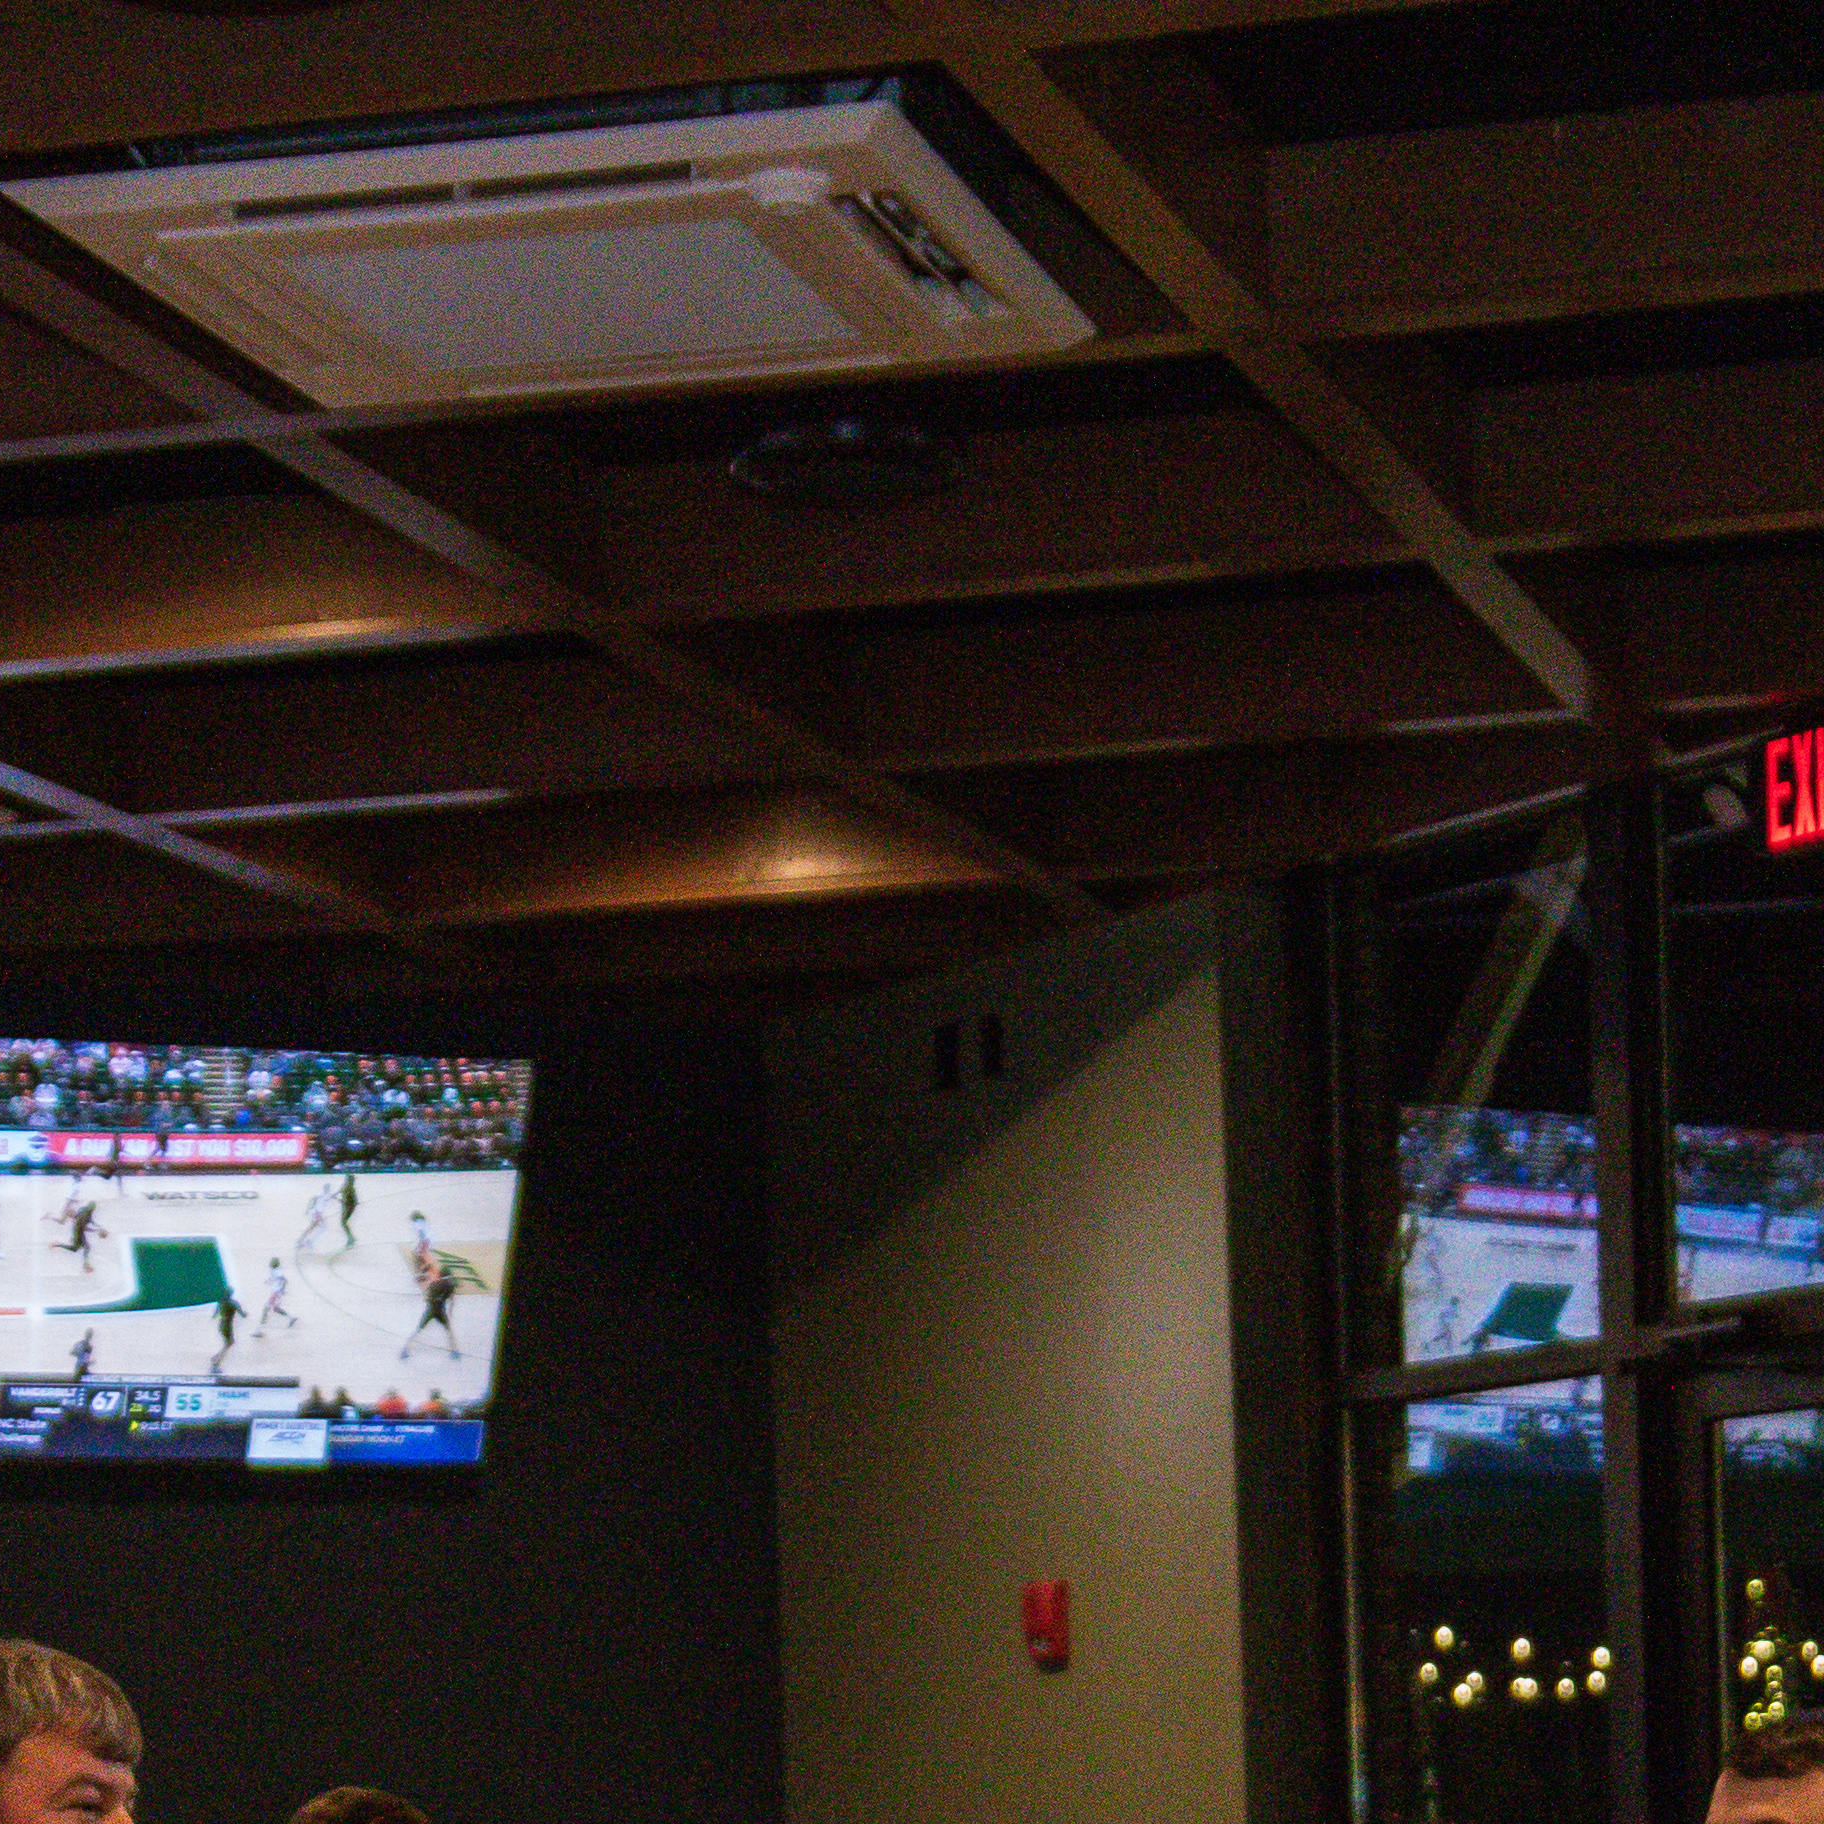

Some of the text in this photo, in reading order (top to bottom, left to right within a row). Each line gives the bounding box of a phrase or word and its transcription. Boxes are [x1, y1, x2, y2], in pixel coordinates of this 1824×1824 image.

[143, 1190, 260, 1201] WATSCO
[90, 1390, 120, 1411] 67
[175, 1393, 203, 1411] 55
